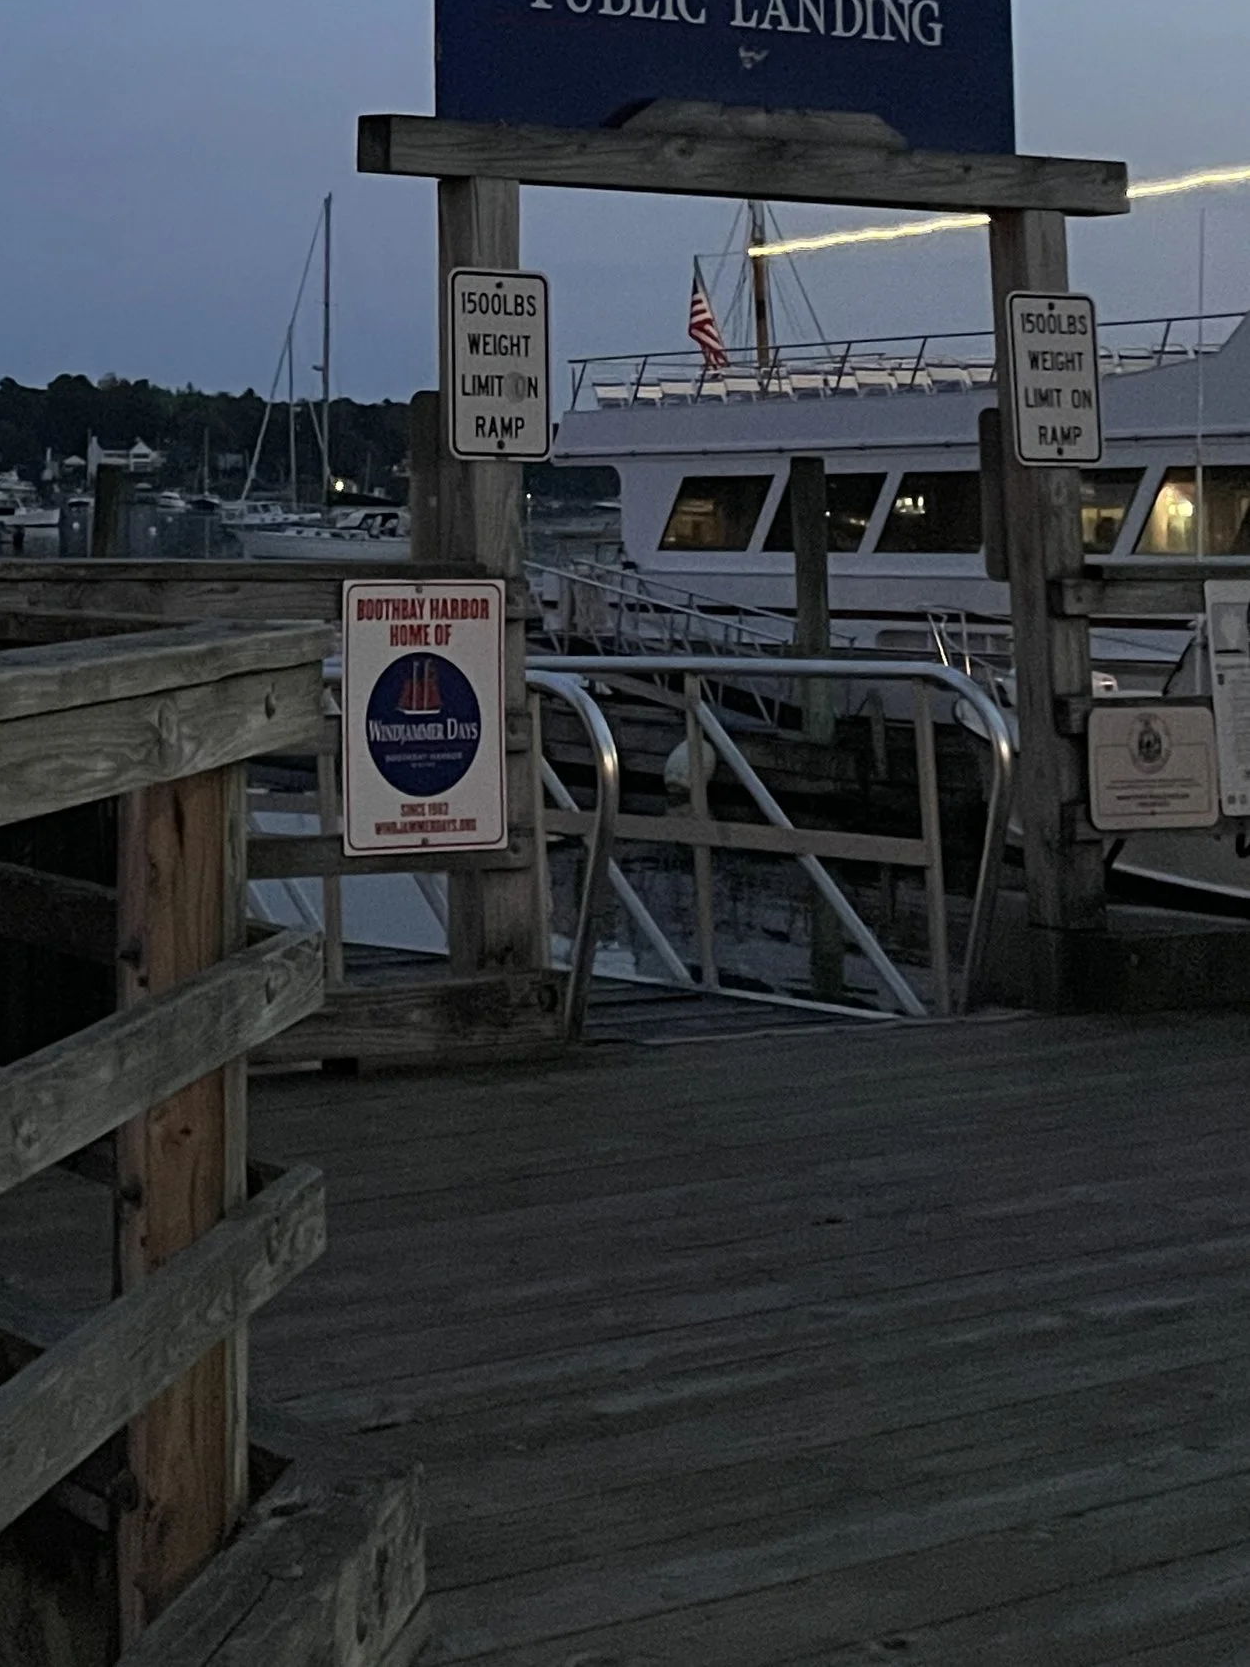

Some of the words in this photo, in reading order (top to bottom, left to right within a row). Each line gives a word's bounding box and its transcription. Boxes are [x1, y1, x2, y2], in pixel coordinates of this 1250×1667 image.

[461, 292, 537, 317] 1500LBS
[1020, 313, 1088, 335] 1500LBS
[467, 333, 531, 357] WEIGHT
[1028, 350, 1084, 371] WEIGHT
[461, 374, 504, 397] LIMIT
[514, 376, 538, 398] ON
[1024, 386, 1063, 408] LIMIT
[1071, 389, 1093, 409] ON
[475, 416, 525, 439] RAMP
[1038, 425, 1083, 447] RAMP
[357, 598, 425, 621] BOOTHBAY
[430, 598, 489, 620] HARBOR
[390, 624, 430, 646] HOME
[434, 624, 452, 646] OF
[446, 718, 479, 741] DAYS
[401, 803, 426, 817] SINCE
